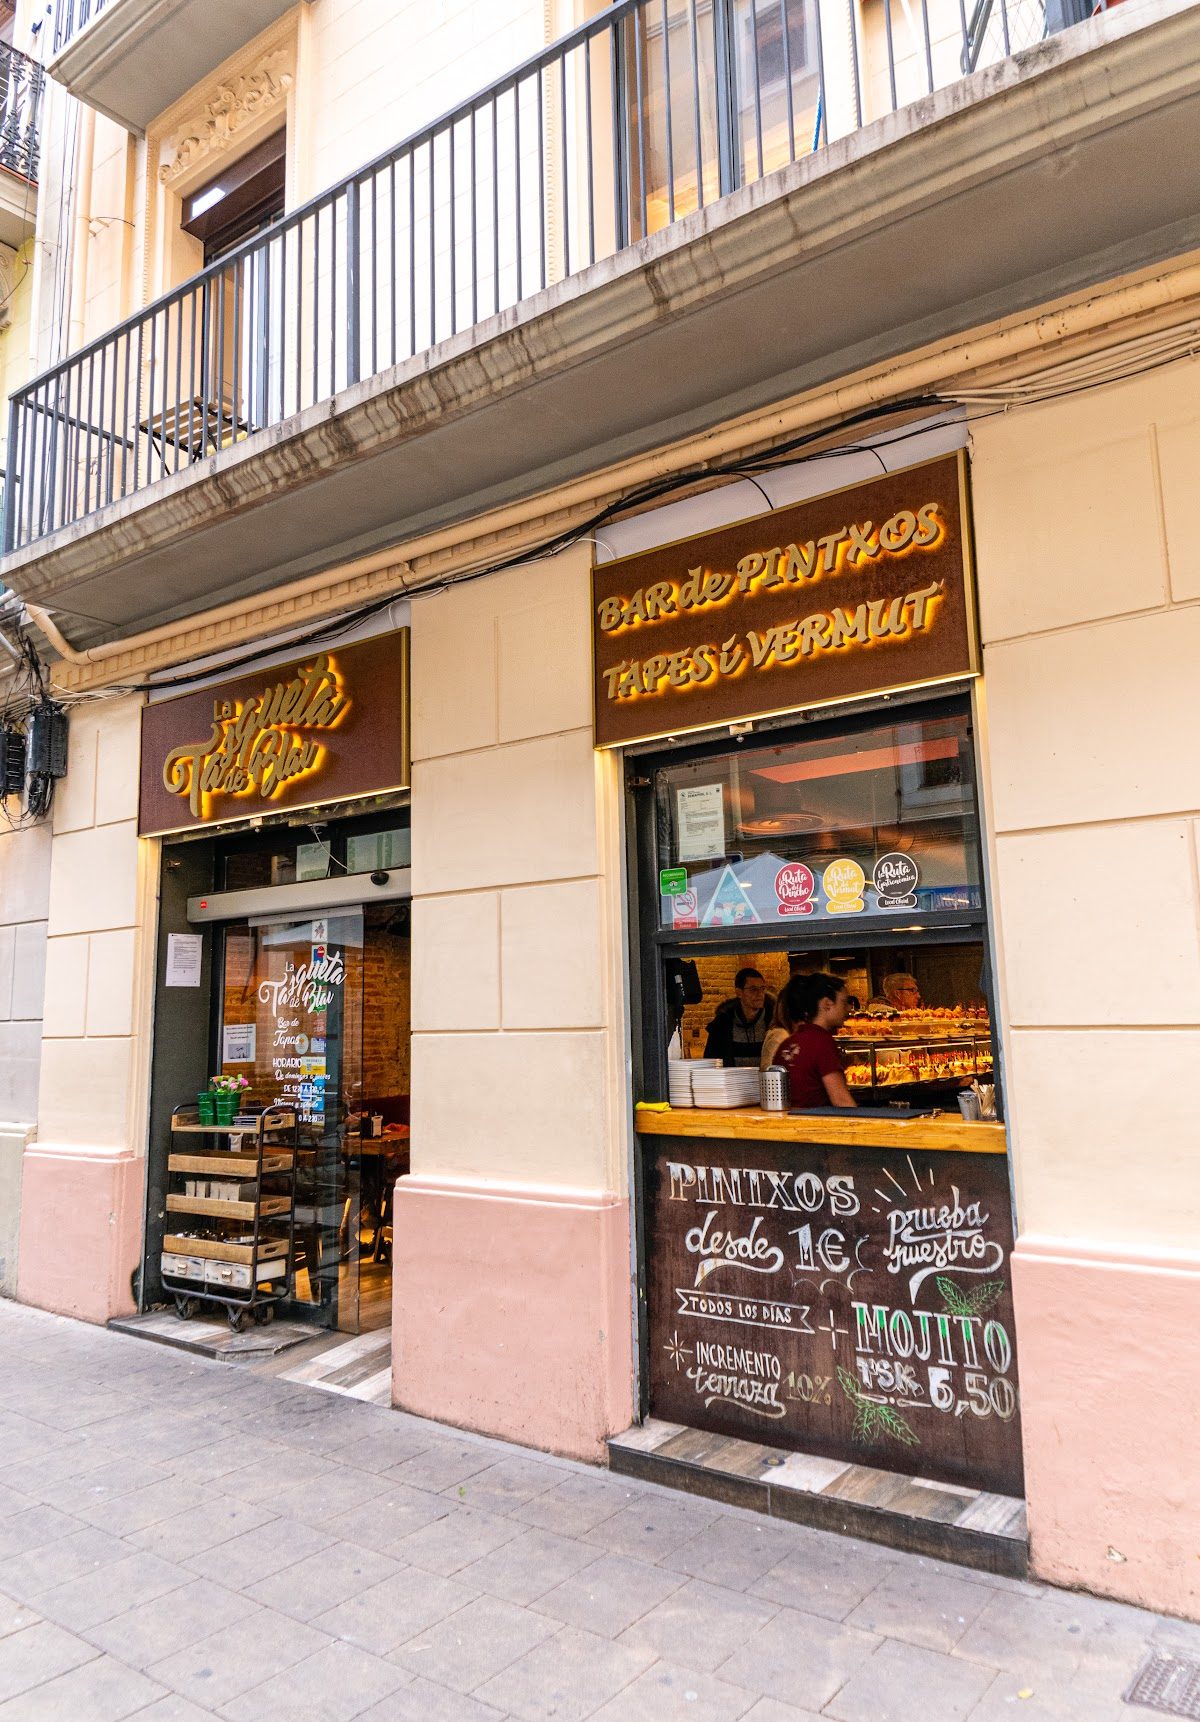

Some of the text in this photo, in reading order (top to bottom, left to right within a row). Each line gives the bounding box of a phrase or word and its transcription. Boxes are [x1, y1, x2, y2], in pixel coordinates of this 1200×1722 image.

[598, 502, 942, 631] BAR de PINTXOS
[602, 645, 715, 700] TAPES
[746, 578, 944, 667] VERMUT
[213, 699, 236, 721] La
[223, 767, 247, 794] de
[782, 869, 807, 885] Ruta
[831, 866, 857, 883] Ruta
[882, 861, 911, 878] Ruta
[779, 884, 809, 899] Pincho
[286, 962, 294, 972] La
[290, 996, 300, 1007] de
[291, 1018, 299, 1026] de
[273, 1028, 300, 1048] Tapas
[272, 1058, 302, 1068] HORARIO
[666, 1161, 860, 1216] PINTXOS
[685, 1211, 850, 1286] desde 1€
[689, 1296, 732, 1316] TODOS
[739, 1303, 757, 1319] LOS
[852, 1302, 1011, 1374] MOJITO
[696, 1341, 781, 1380] INCREMENTO
[686, 1366, 833, 1418] terraza 10%
